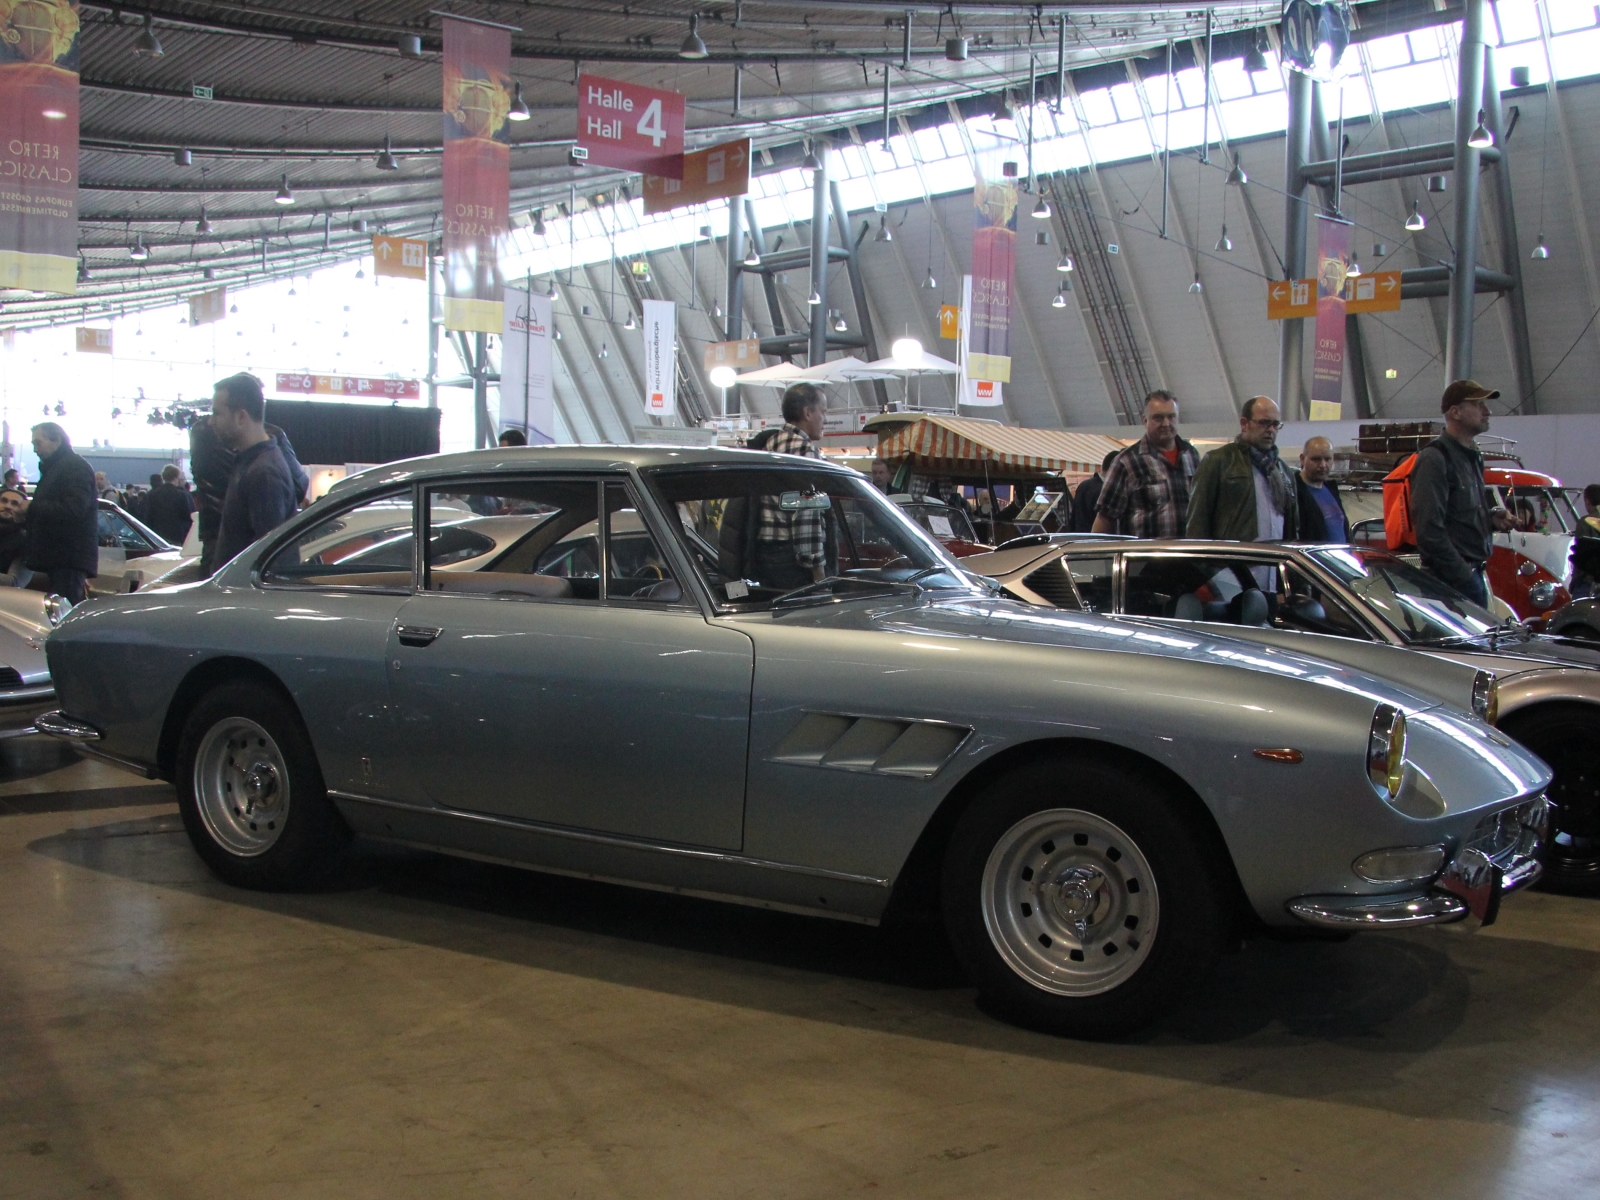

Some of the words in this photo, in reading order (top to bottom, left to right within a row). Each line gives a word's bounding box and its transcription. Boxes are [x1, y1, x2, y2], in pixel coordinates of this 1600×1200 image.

[588, 85, 634, 112] Halle
[587, 115, 622, 140] Hall
[636, 98, 667, 148] 4
[302, 375, 312, 388] 6
[396, 382, 405, 394] 2
